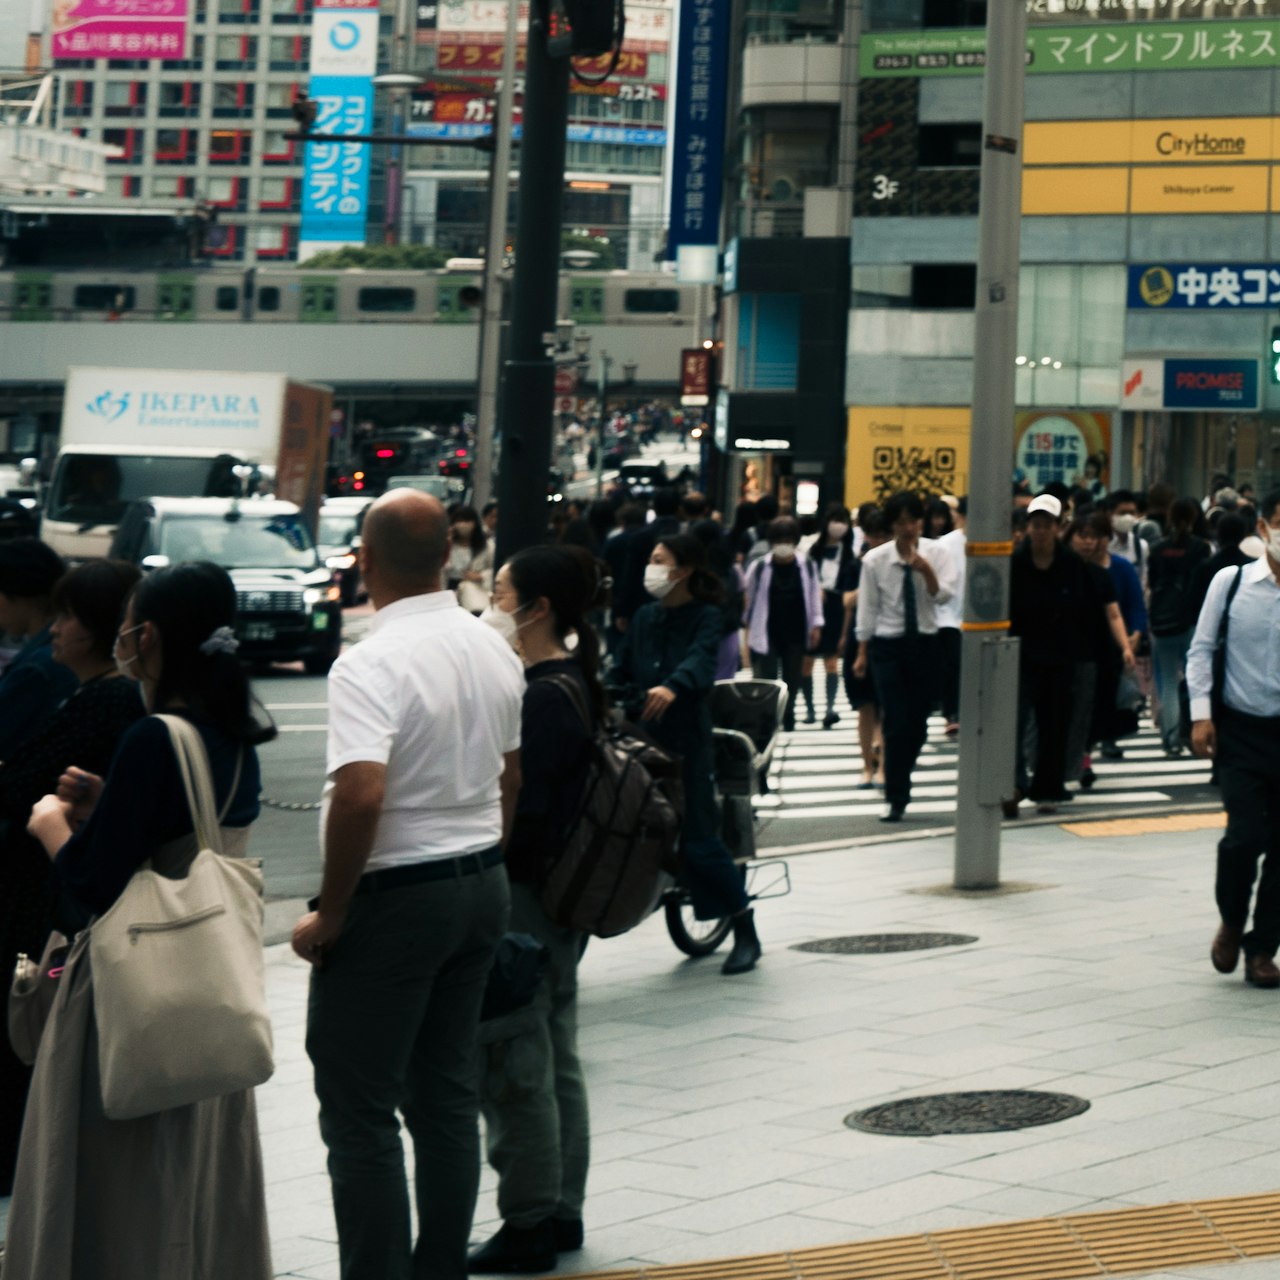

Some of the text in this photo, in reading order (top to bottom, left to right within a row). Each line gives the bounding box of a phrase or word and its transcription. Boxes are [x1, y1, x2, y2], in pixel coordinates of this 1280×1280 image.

[1047, 28, 1277, 66] マインドフルネス
[412, 99, 434, 116] 7F
[1156, 131, 1246, 156] CityHome
[872, 175, 899, 200] 3F
[1175, 372, 1244, 390] PROMISE
[139, 391, 260, 415] IKEPARA
